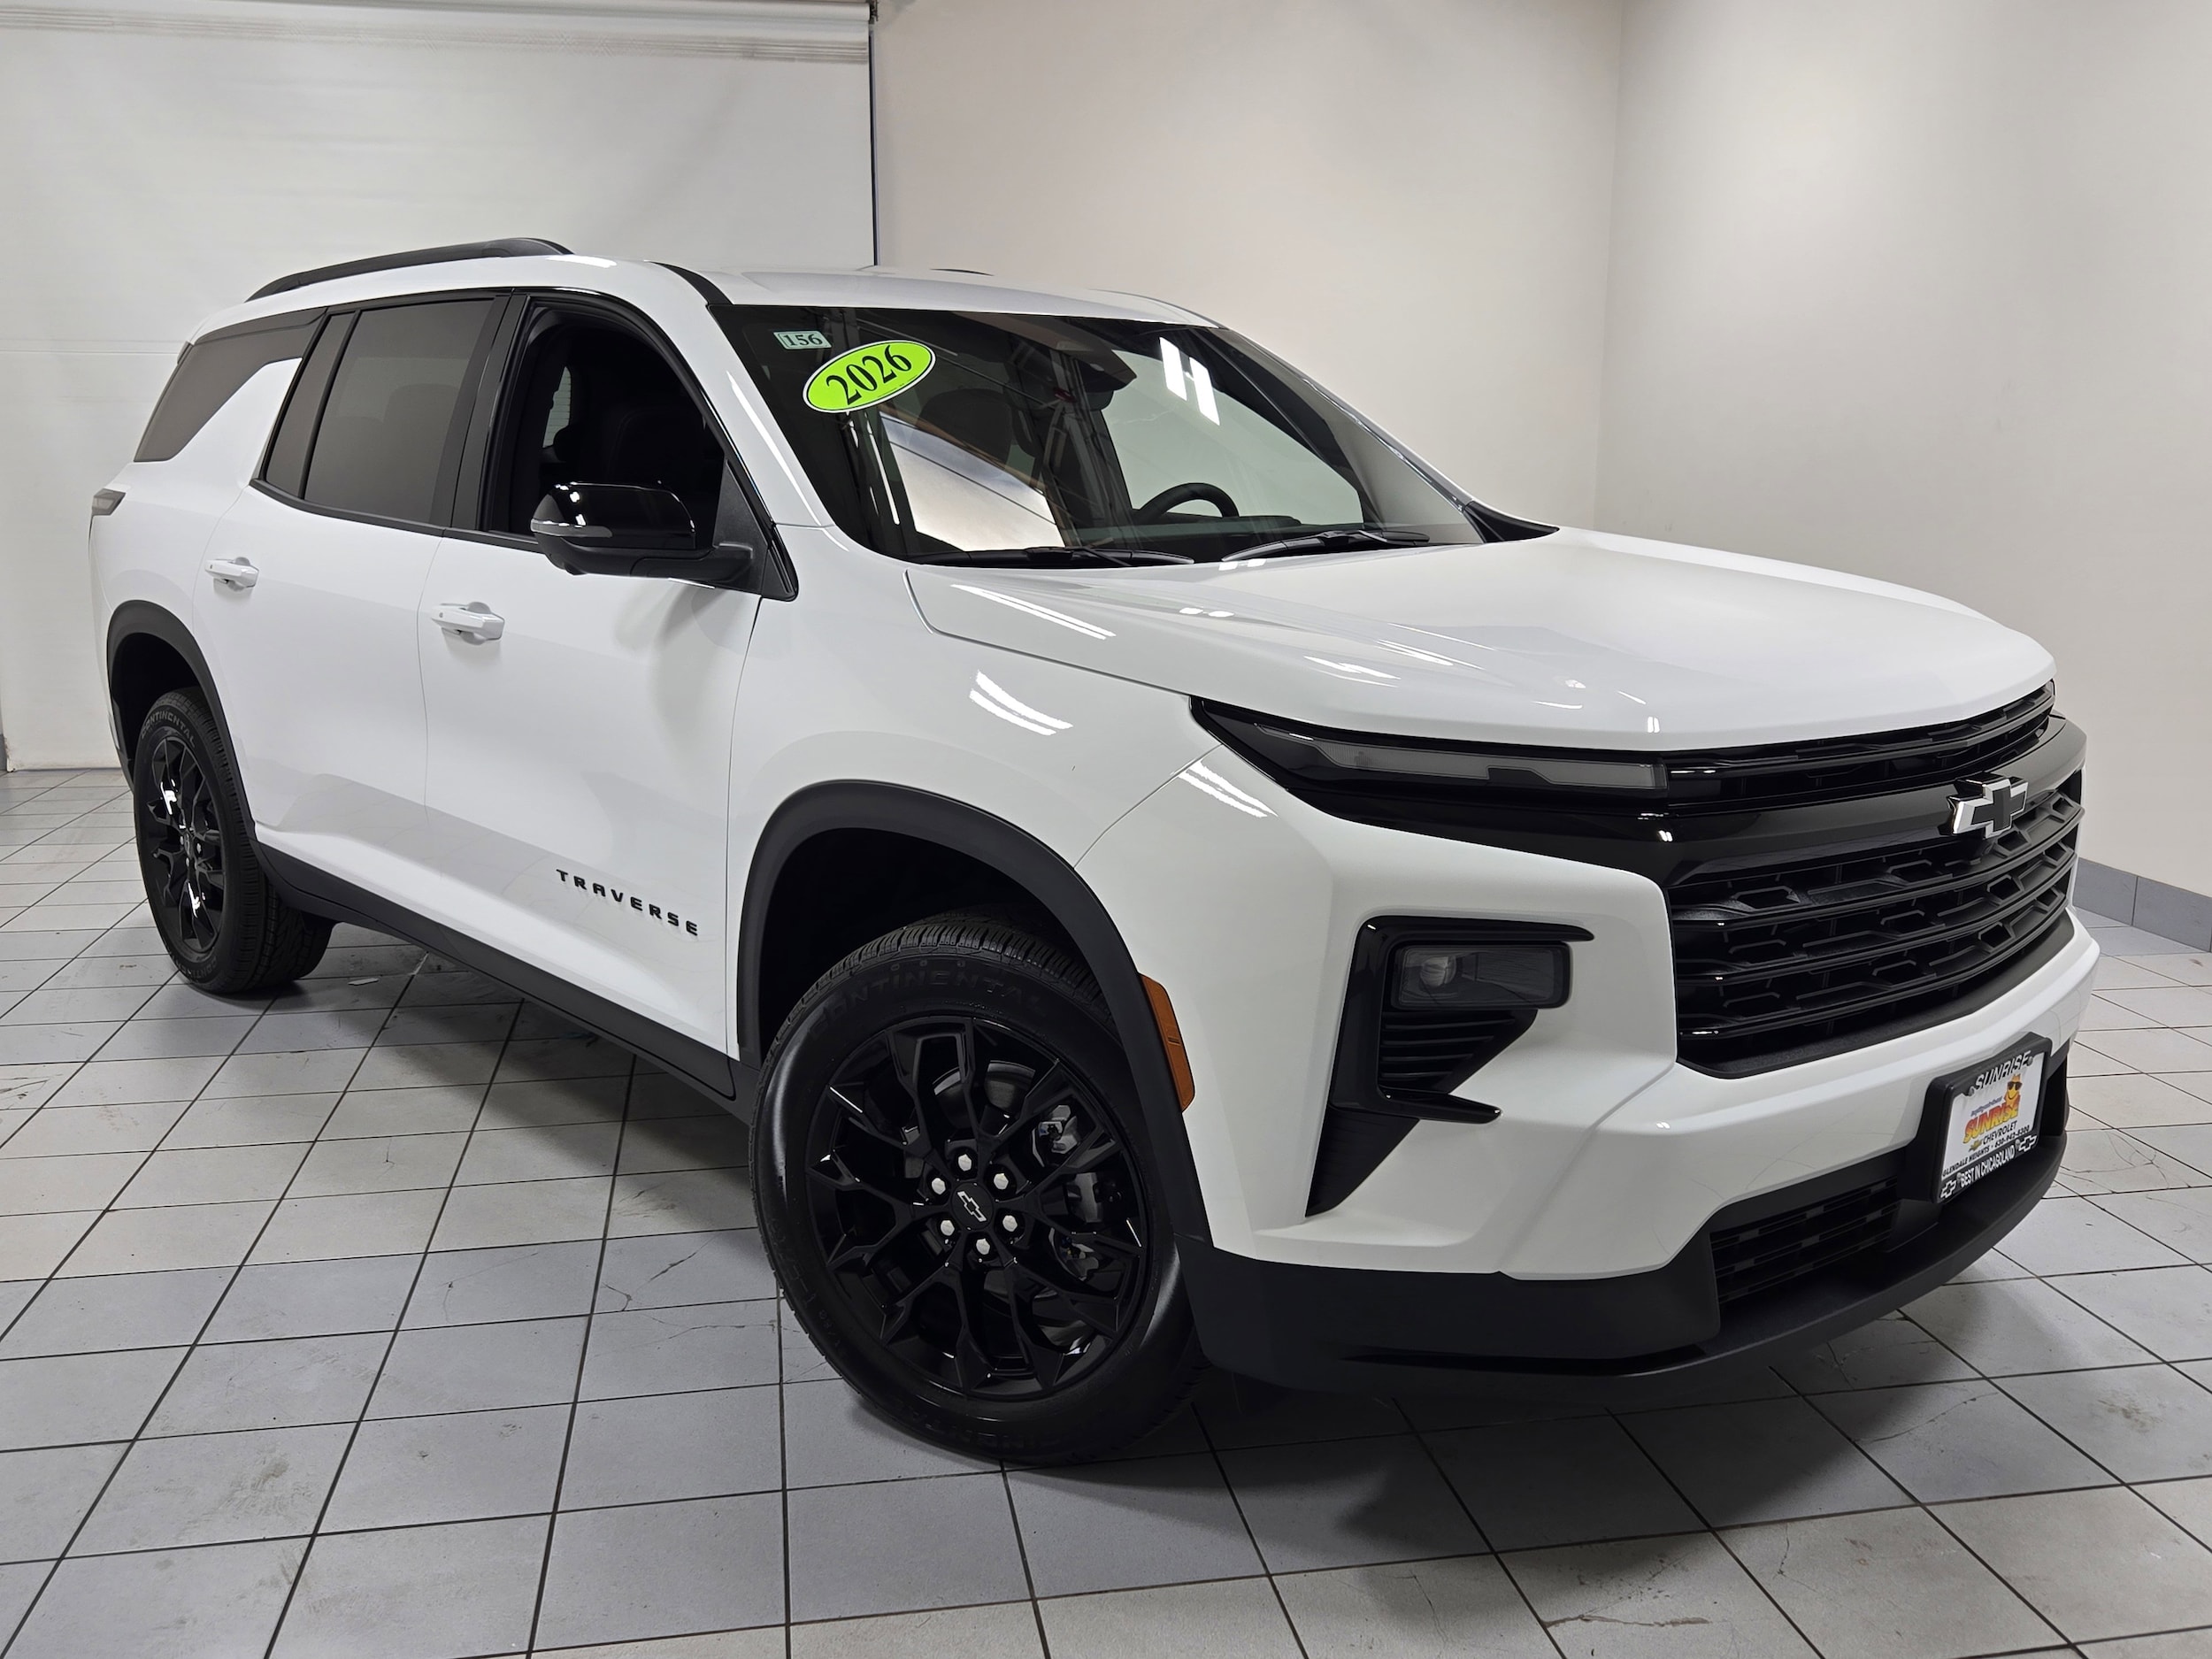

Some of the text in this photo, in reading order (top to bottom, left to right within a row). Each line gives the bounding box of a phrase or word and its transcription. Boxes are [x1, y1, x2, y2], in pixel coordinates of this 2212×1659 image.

[783, 334, 823, 347] 156
[826, 344, 912, 406] 2026
[556, 868, 698, 936] TRAVERSE
[1975, 1050, 2032, 1091] SUNRISE
[1962, 1095, 2020, 1143] SUNRISE
[1983, 1120, 2017, 1144] CHEVROLET
[1961, 1144, 2016, 1187] BEST IN CHICAGOLAND
